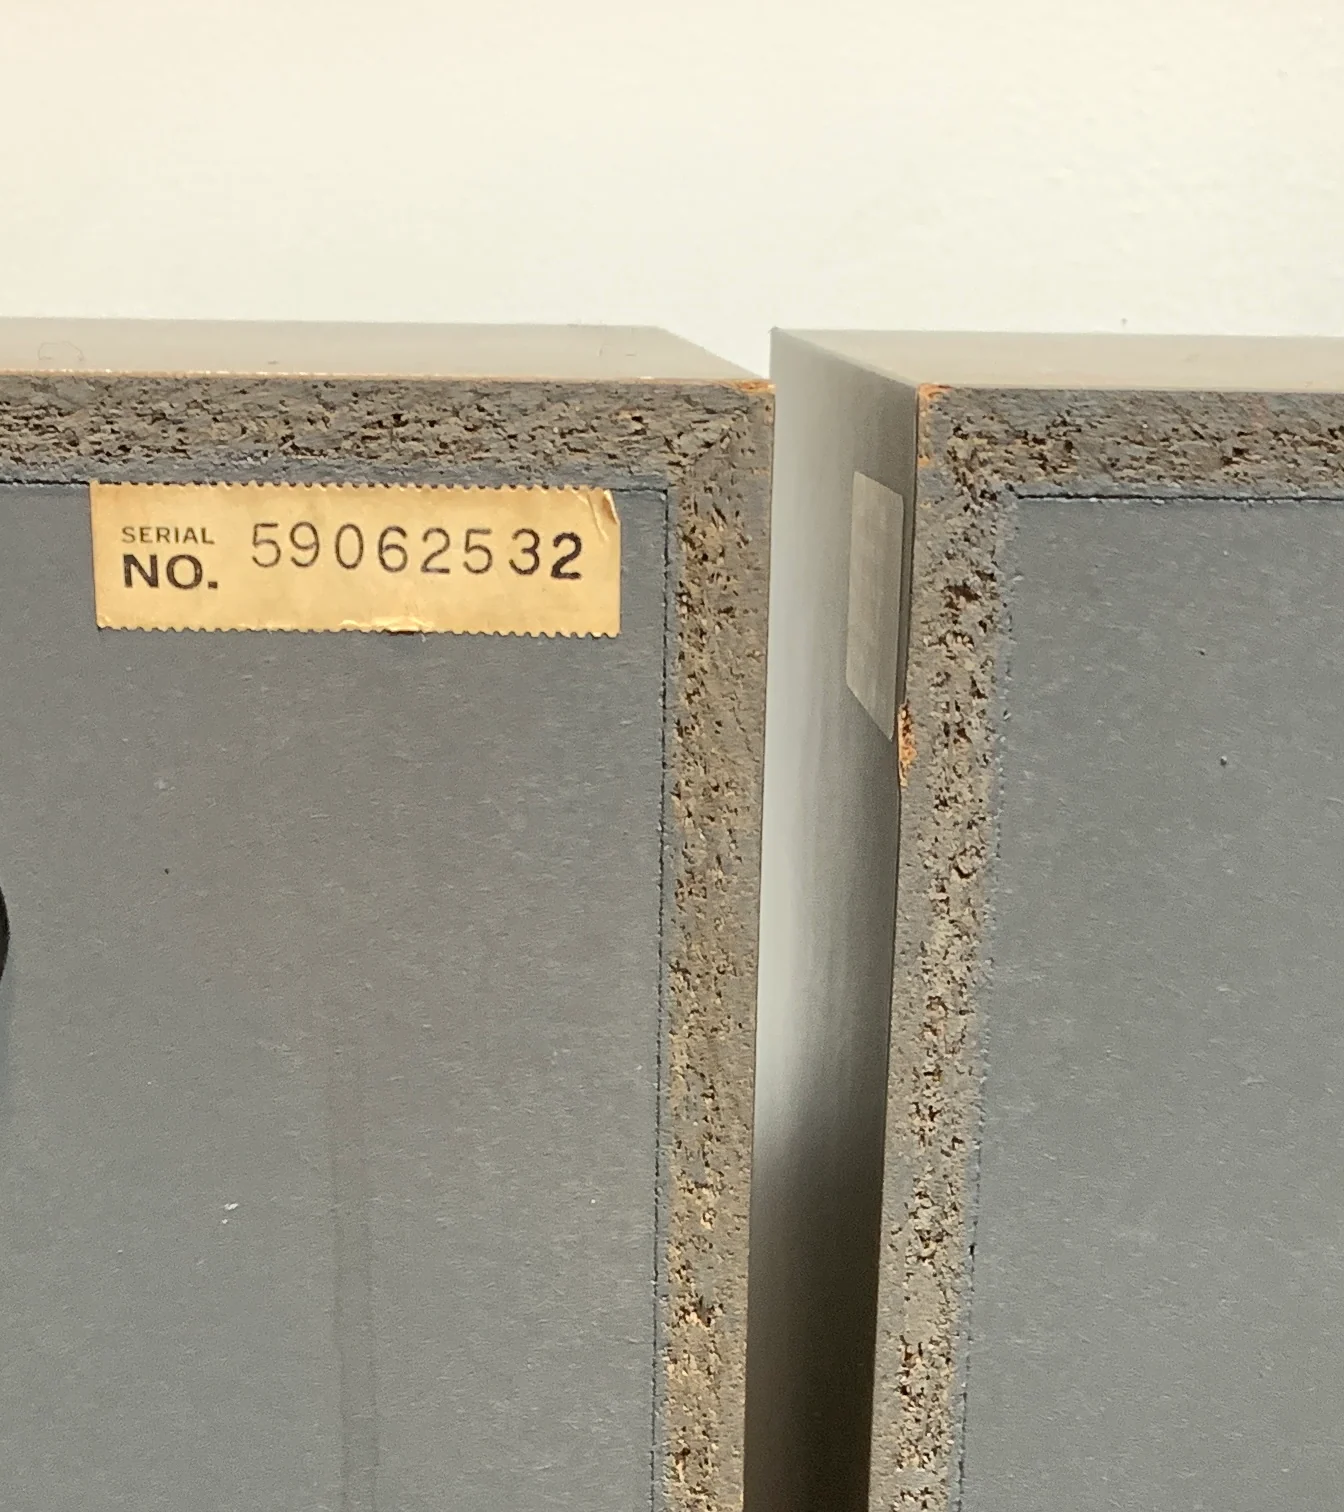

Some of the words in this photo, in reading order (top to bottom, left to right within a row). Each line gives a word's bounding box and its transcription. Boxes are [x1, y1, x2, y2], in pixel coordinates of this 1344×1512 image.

[121, 526, 215, 544] SERIAL
[123, 554, 219, 590] NO.
[251, 521, 582, 580] 59062532
